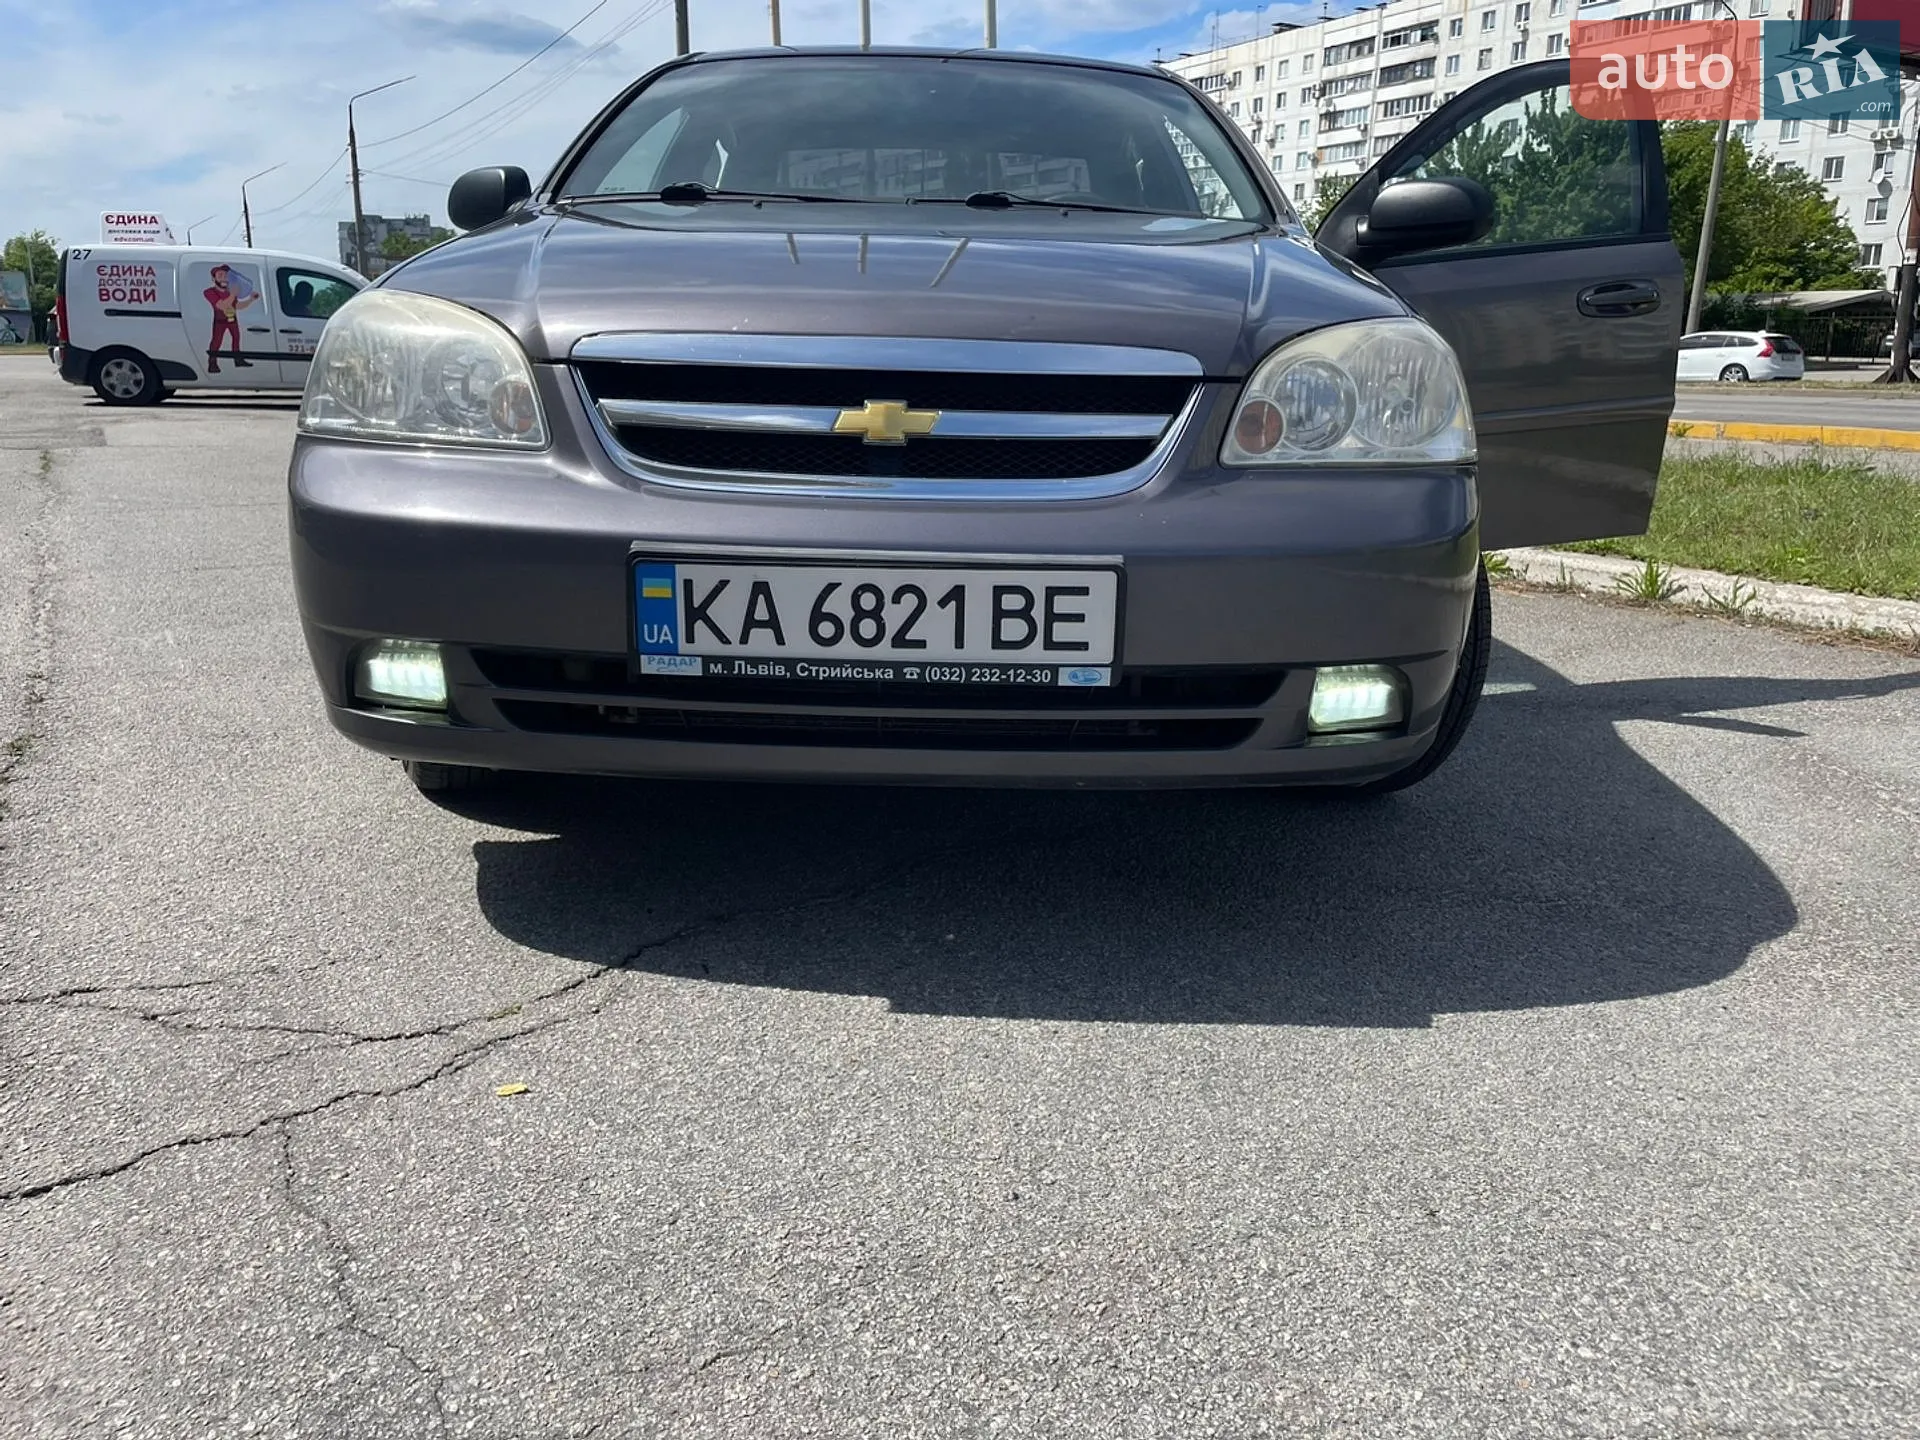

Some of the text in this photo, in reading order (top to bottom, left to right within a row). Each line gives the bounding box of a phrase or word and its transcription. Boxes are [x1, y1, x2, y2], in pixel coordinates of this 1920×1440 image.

[105, 214, 158, 226] ЄДИНА
[72, 249, 92, 260] 27
[97, 265, 156, 278] ЄДИНА
[98, 278, 157, 287] ДОСТАВКА
[98, 288, 156, 304] ВОДИ
[683, 579, 1090, 651] KA 6821 BE
[643, 624, 674, 644] UA
[647, 656, 697, 668] РАДАР
[709, 662, 727, 674] м.
[733, 661, 791, 678] Львів,
[796, 663, 894, 680] Стрийська
[925, 666, 966, 683] (032)
[970, 668, 1051, 683] 232-12-30
